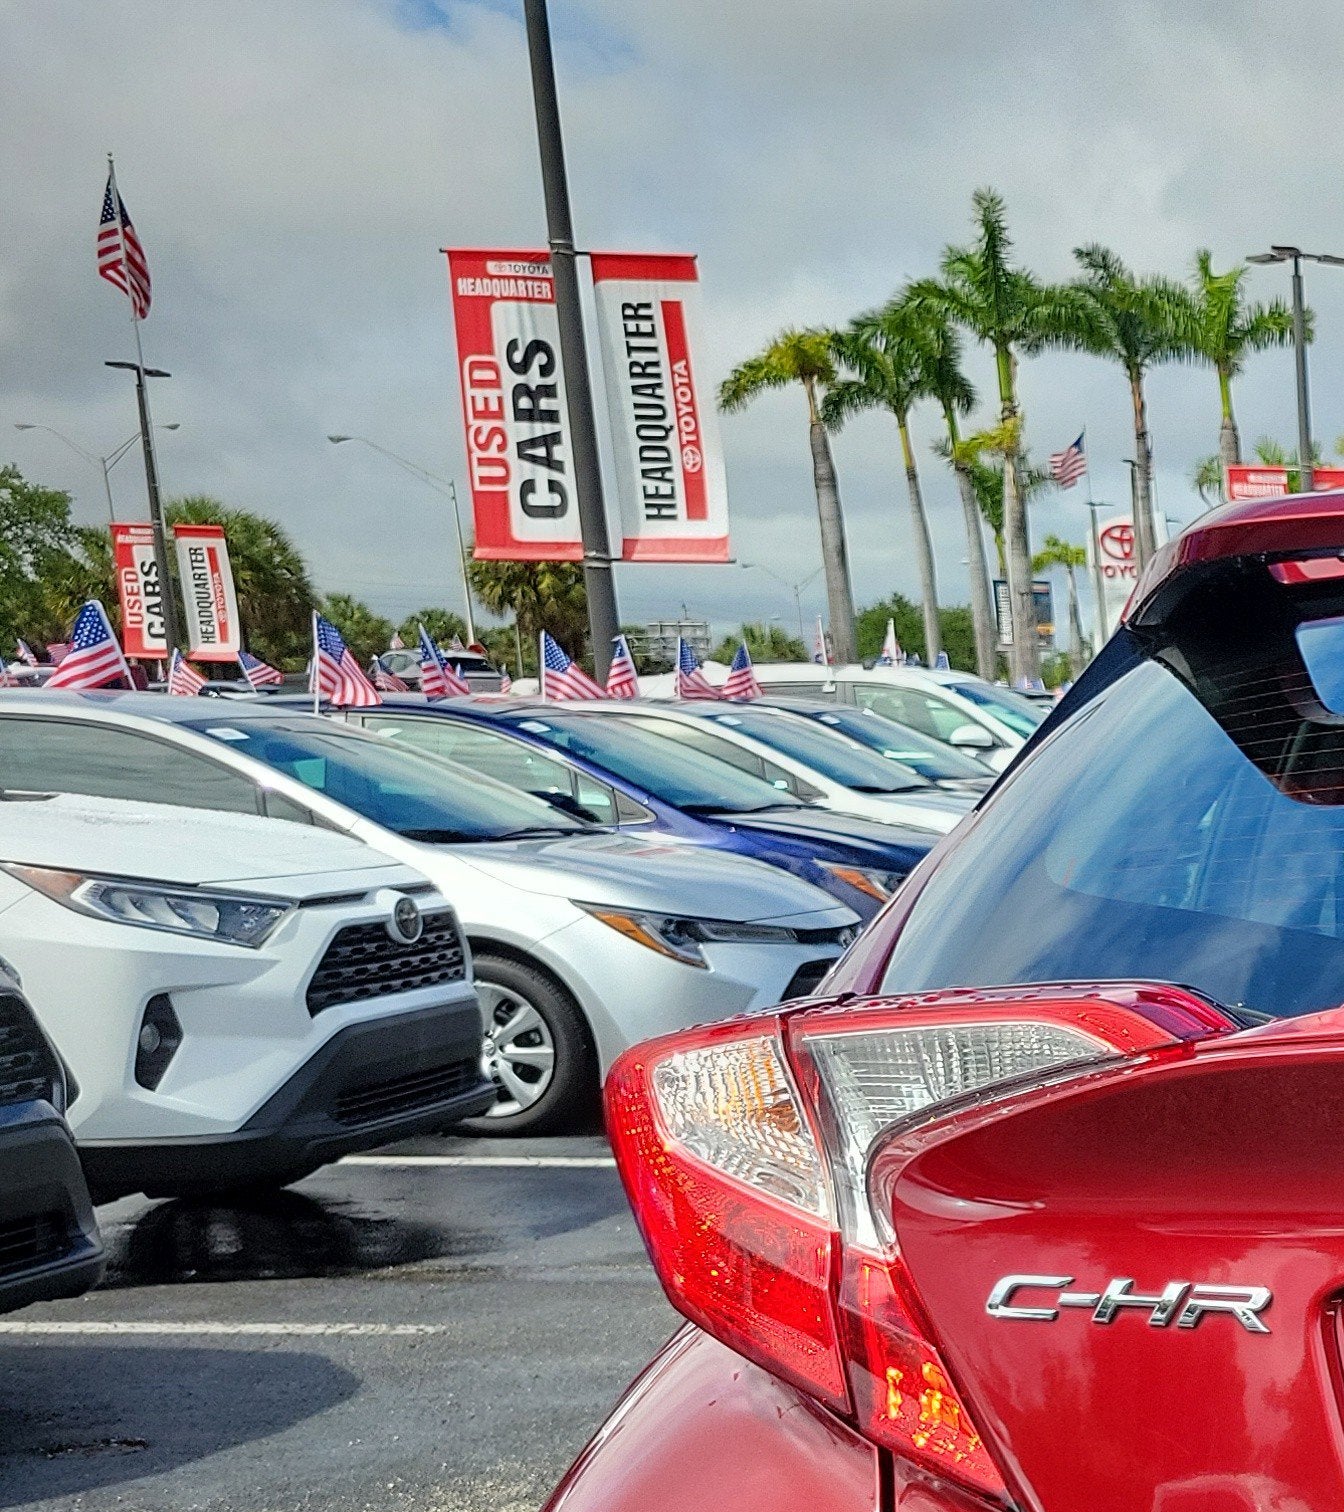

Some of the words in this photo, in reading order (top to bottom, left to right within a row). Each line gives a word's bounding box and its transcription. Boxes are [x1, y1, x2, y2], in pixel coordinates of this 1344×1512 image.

[457, 277, 552, 299] HEADQUARTER
[507, 263, 549, 275] TOYOTA
[467, 358, 510, 490] USED
[506, 338, 569, 519] CARS
[621, 301, 678, 521] HEADQUARTER
[672, 359, 698, 443] TOYOTA
[124, 569, 144, 625] USED
[141, 560, 165, 639] CARS
[189, 546, 216, 644] HEADQUARTER
[986, 1274, 1272, 1334] C-HR
